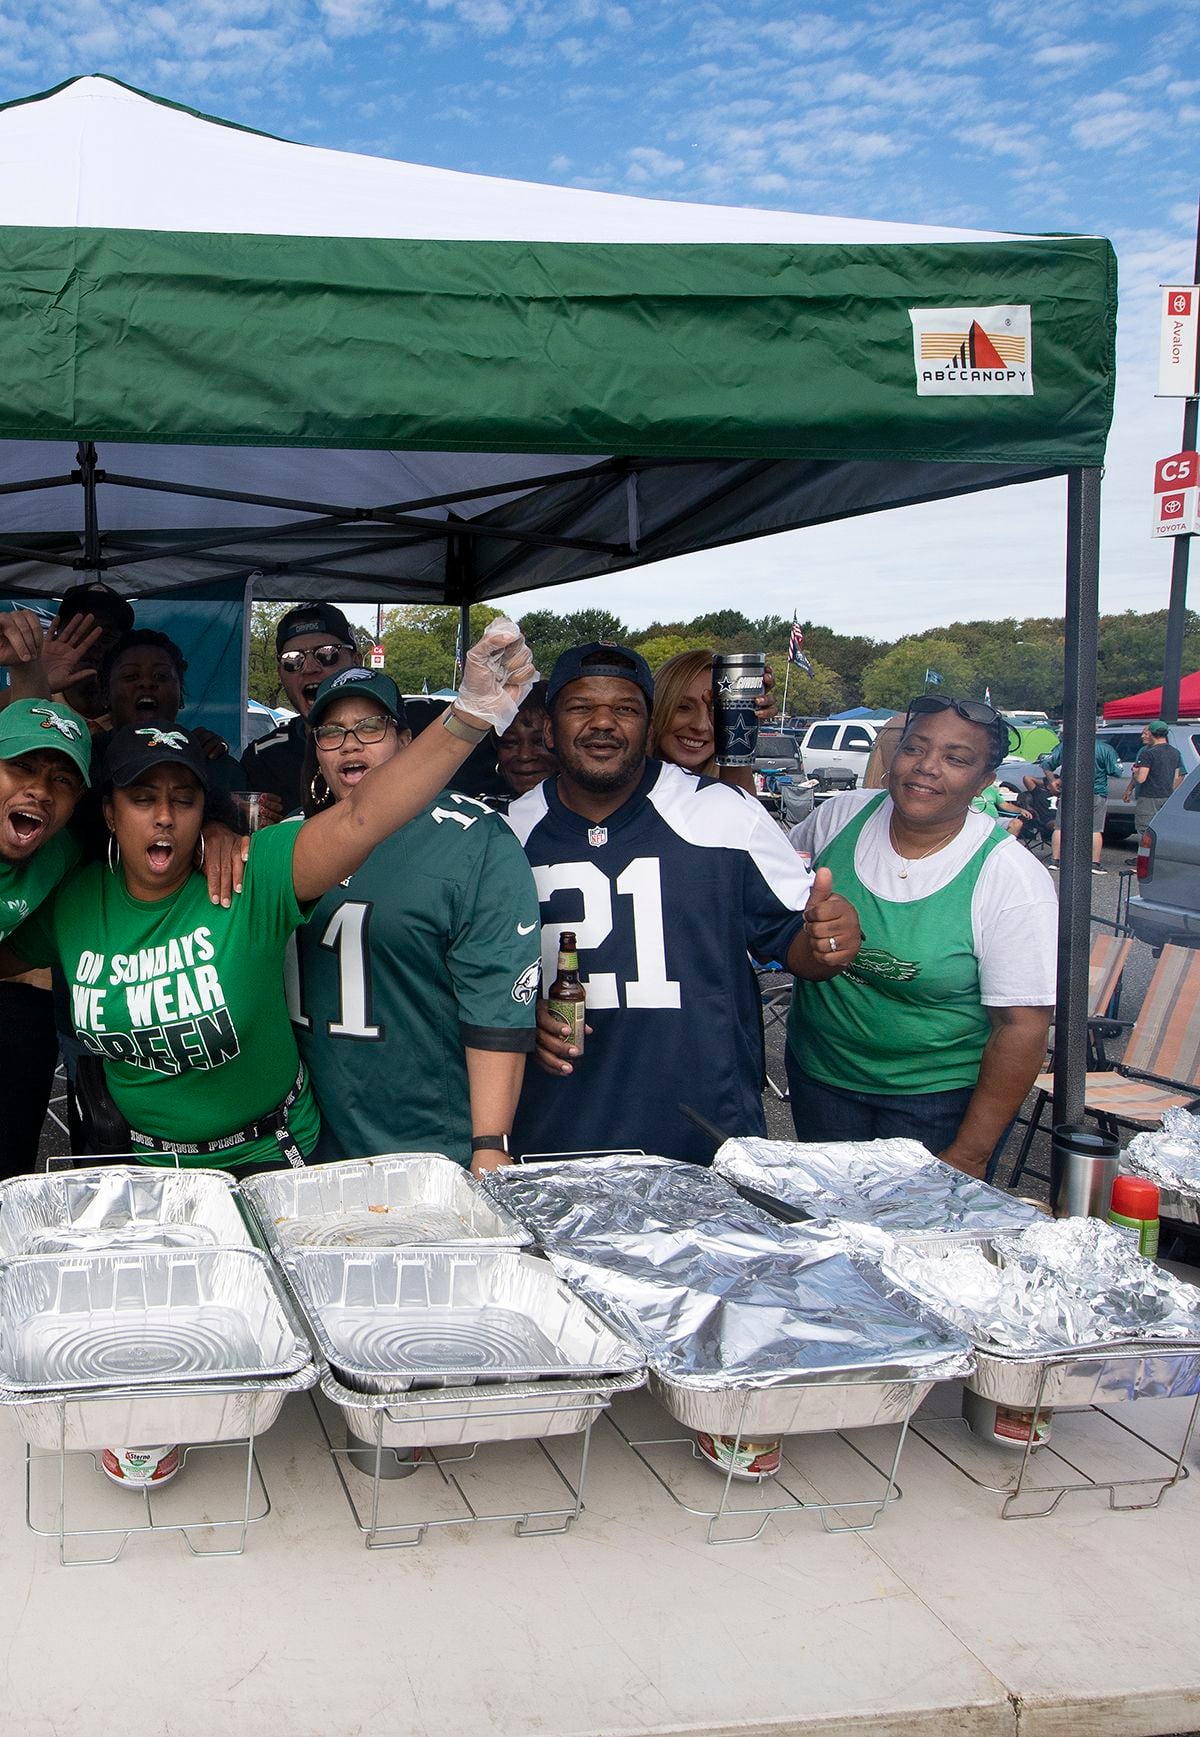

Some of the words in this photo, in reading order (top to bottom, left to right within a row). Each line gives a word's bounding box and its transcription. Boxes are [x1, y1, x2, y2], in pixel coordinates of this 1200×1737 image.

[1171, 320, 1184, 364] Avalon
[922, 371, 1026, 381] ABCCANOPY
[1161, 460, 1190, 481] C5
[1156, 523, 1186, 533] TOYOTA
[431, 793, 496, 831] 11
[531, 857, 681, 1009] 21
[76, 950, 104, 985] ON
[109, 926, 215, 986] SUNDAYS
[72, 984, 107, 1032] WE
[125, 964, 226, 1027] WEAR
[76, 1006, 241, 1076] GREEN
[130, 1129, 155, 1148] INK
[161, 1140, 199, 1154] PINK
[208, 1131, 245, 1152] PINK
